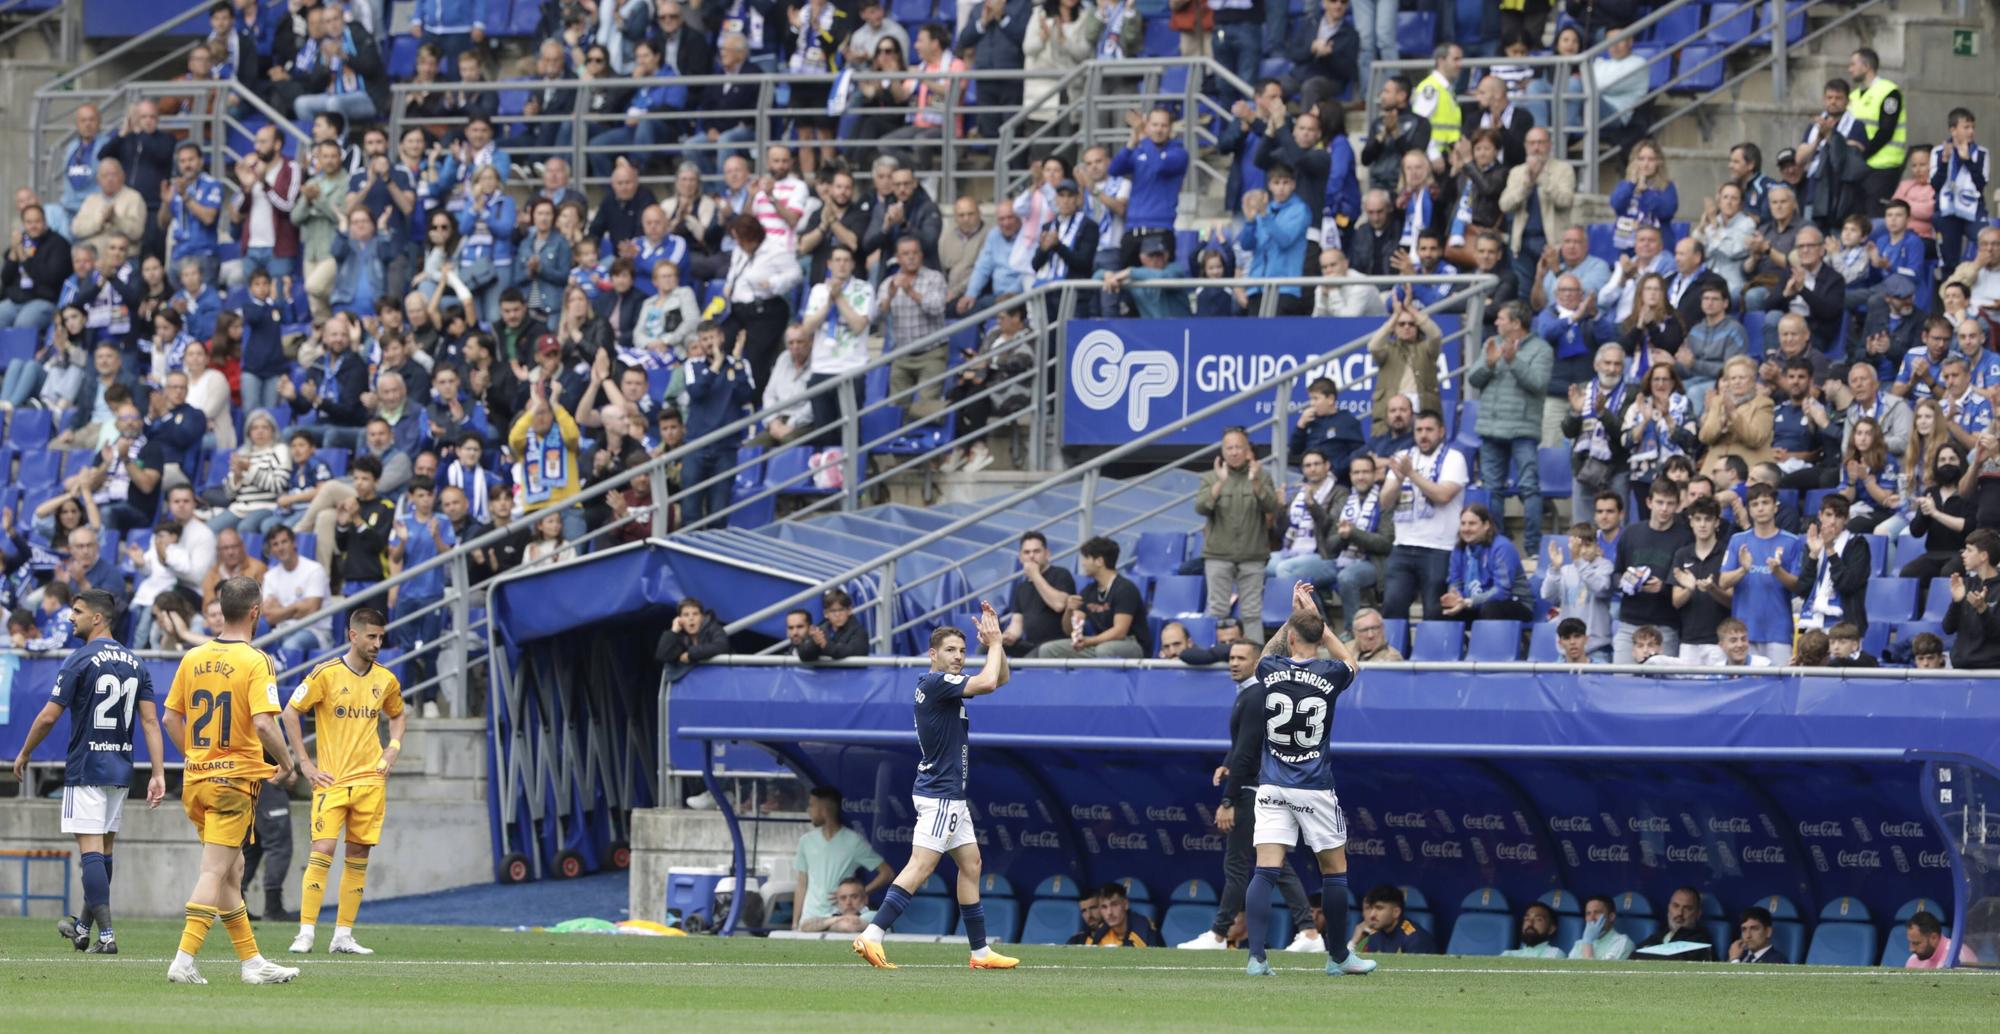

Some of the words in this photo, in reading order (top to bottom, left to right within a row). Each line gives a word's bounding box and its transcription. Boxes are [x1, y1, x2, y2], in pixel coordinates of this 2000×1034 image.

[1196, 354, 1299, 392] GRUPO
[193, 661, 212, 677] ALE
[1294, 671, 1335, 695] ENRICH
[93, 673, 139, 732] 21
[190, 688, 232, 750] 21
[1265, 691, 1328, 748] 23
[88, 741, 121, 752] Tartiere
[1296, 750, 1321, 763] Auto
[317, 793, 327, 813] 7
[949, 813, 958, 833] 8
